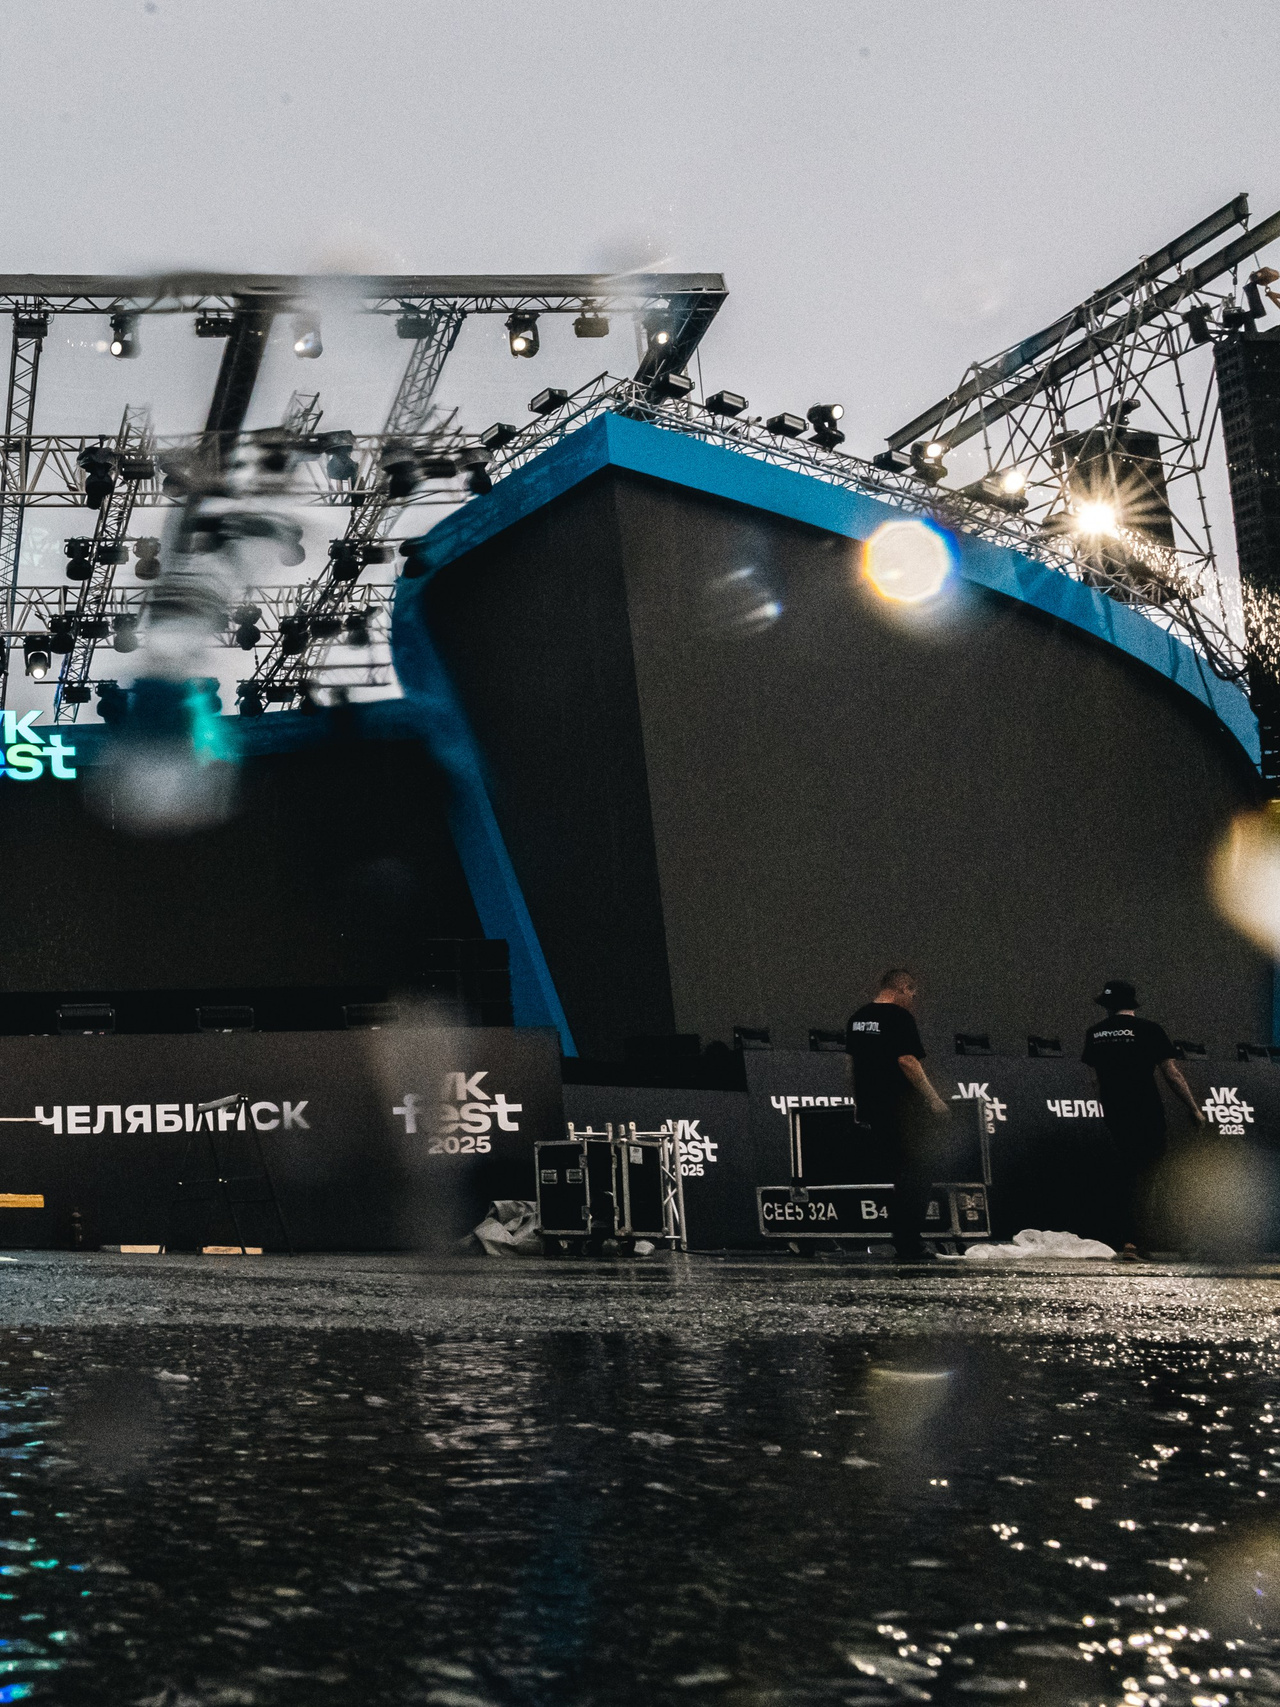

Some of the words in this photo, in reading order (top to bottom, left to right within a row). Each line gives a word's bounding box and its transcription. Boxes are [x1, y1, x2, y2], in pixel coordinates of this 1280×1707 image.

[957, 1082, 991, 1101] VK
[1210, 1086, 1241, 1105] VK
[34, 1100, 310, 1134] ЧЕЛЯБИНСК
[1201, 1098, 1254, 1123] fest
[1218, 1124, 1245, 1135] 2025
[428, 1136, 492, 1154] 2025
[660, 1135, 718, 1163] est
[808, 1202, 838, 1220] 32A
